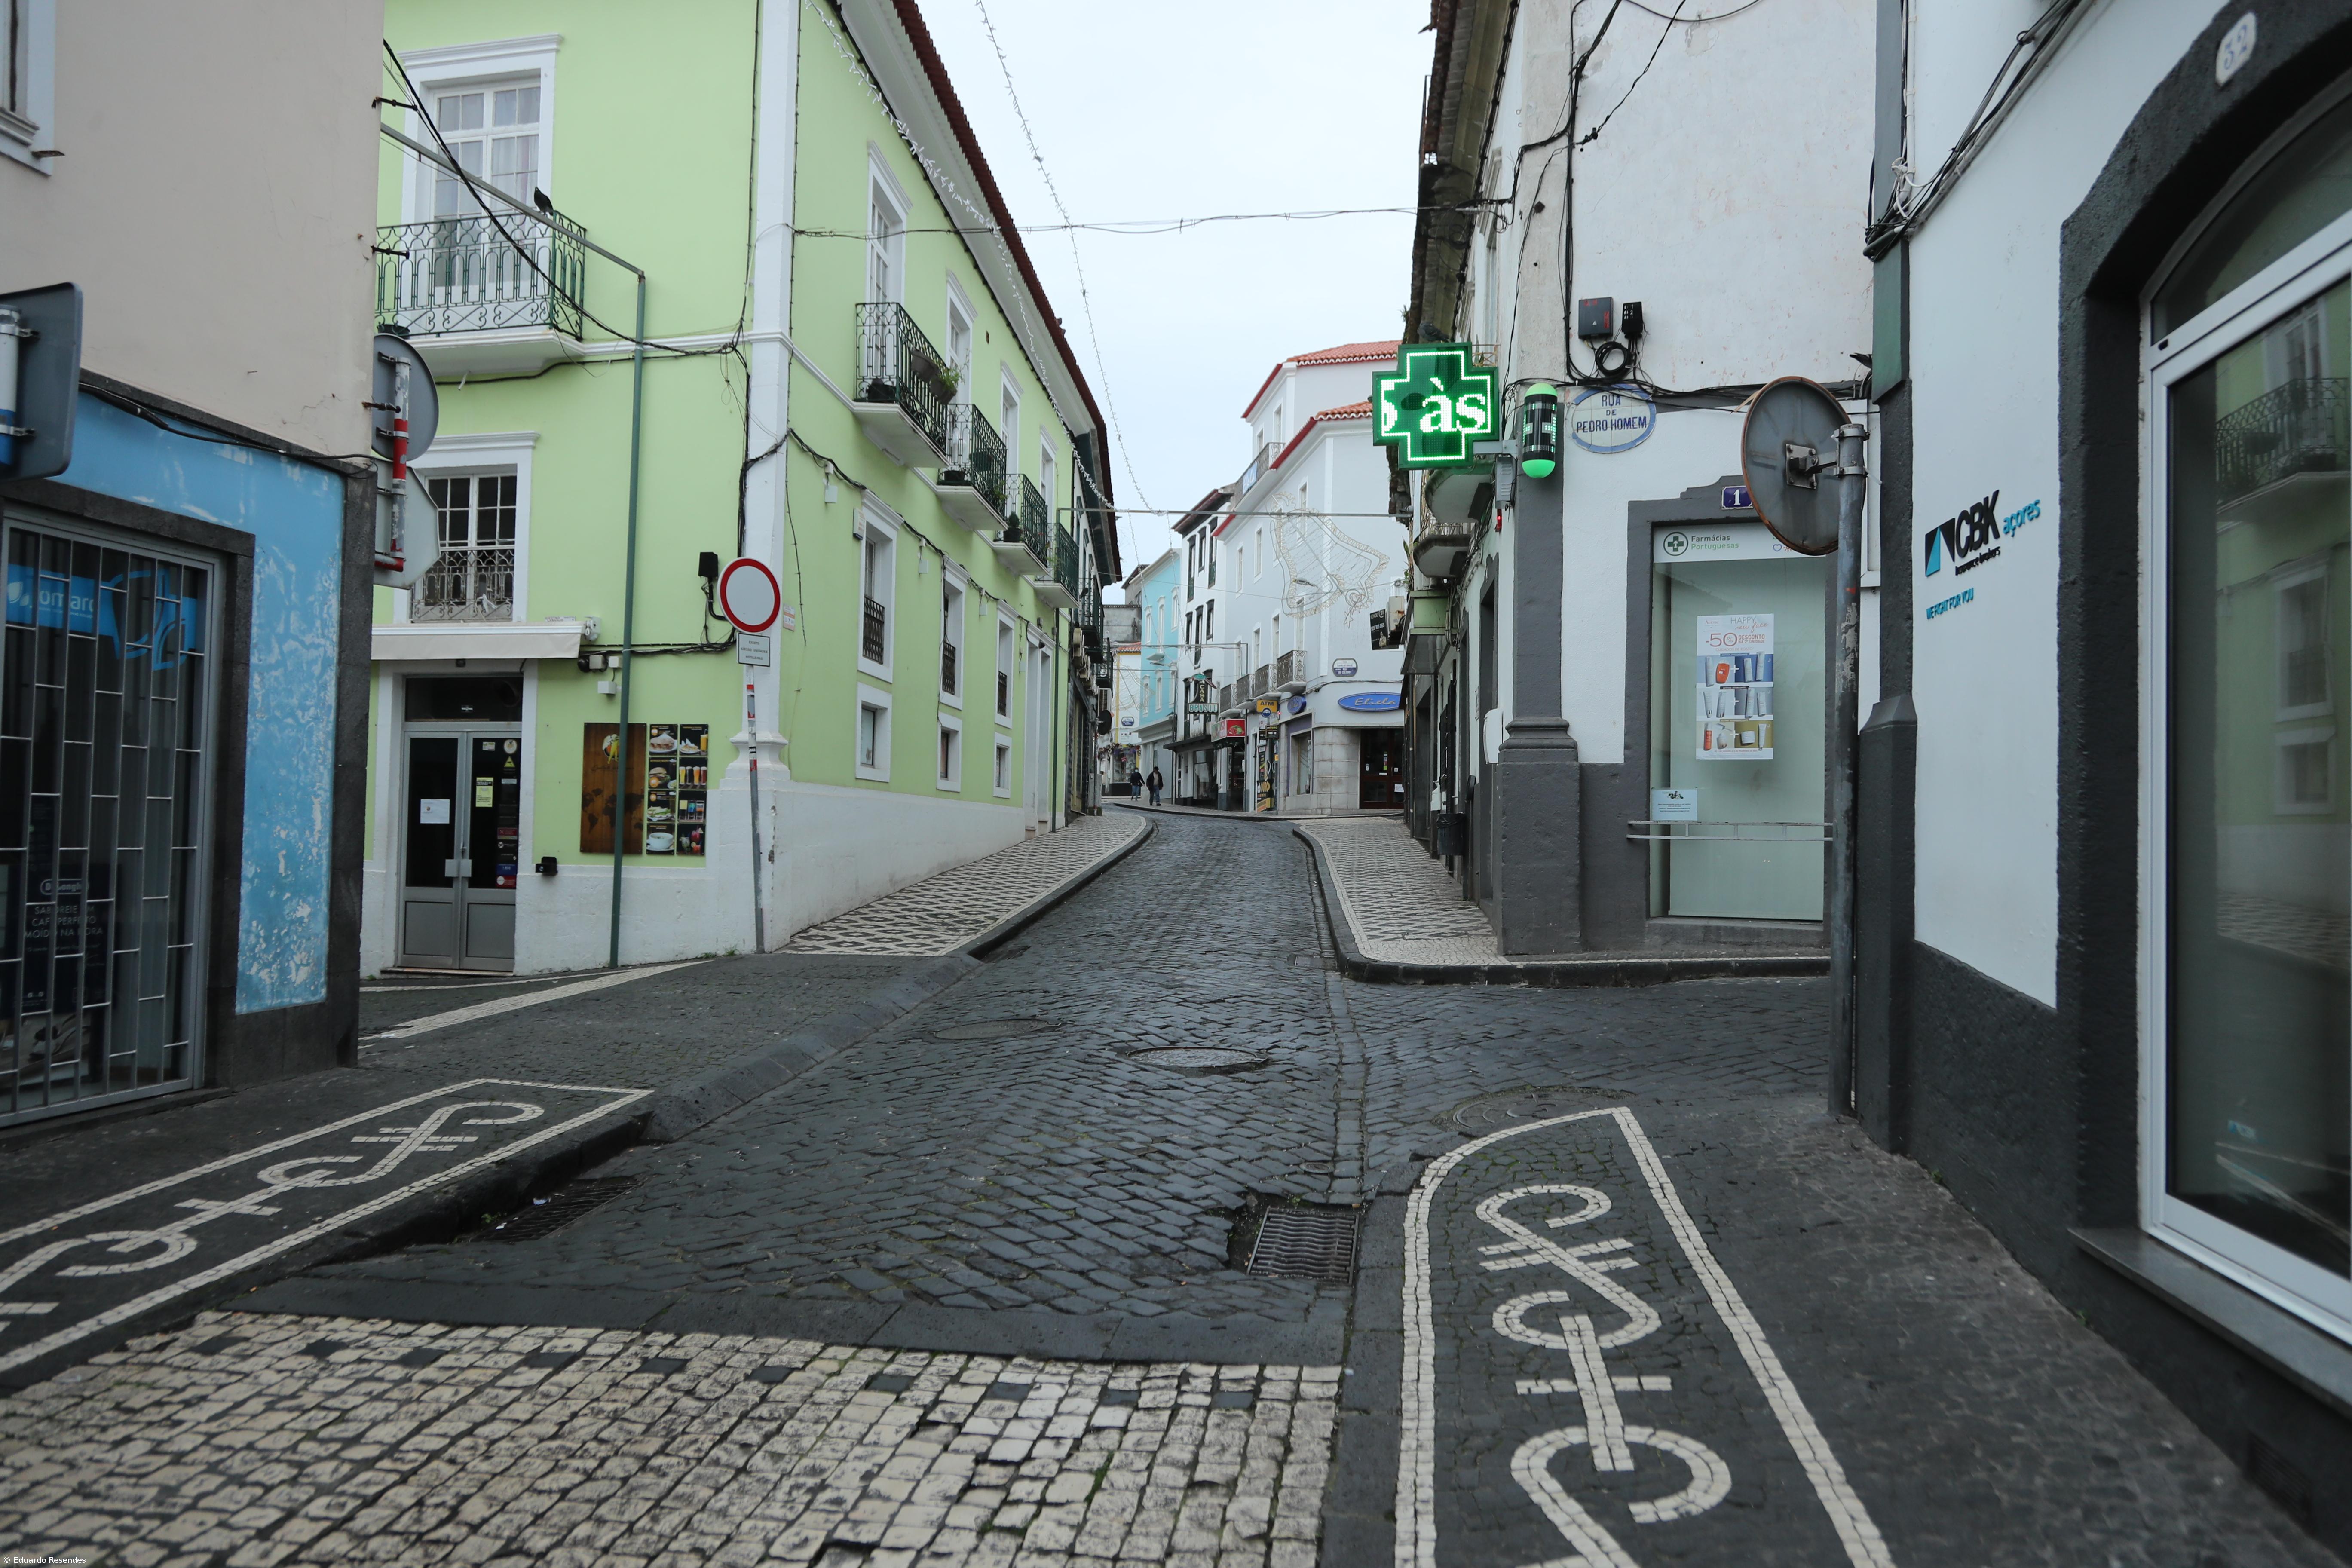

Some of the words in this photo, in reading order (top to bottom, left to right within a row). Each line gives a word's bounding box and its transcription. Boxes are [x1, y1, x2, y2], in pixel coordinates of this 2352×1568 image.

[1420, 377, 1486, 433] às
[1602, 395, 1621, 407] RUA
[1577, 419, 1608, 433] PEDRO
[1611, 416, 1647, 430] HOMEM
[1733, 489, 1741, 505] 1
[1956, 489, 2000, 558] CBK
[2003, 499, 2040, 538] açores
[1691, 534, 1730, 542] Farmácias
[1691, 542, 1740, 551] Portuguesas
[1949, 594, 1961, 609] FOR
[1961, 587, 1974, 604] YOU
[1730, 616, 1757, 624] HAPPY
[1751, 622, 1768, 633] face
[1189, 704, 1218, 713] BRASIL
